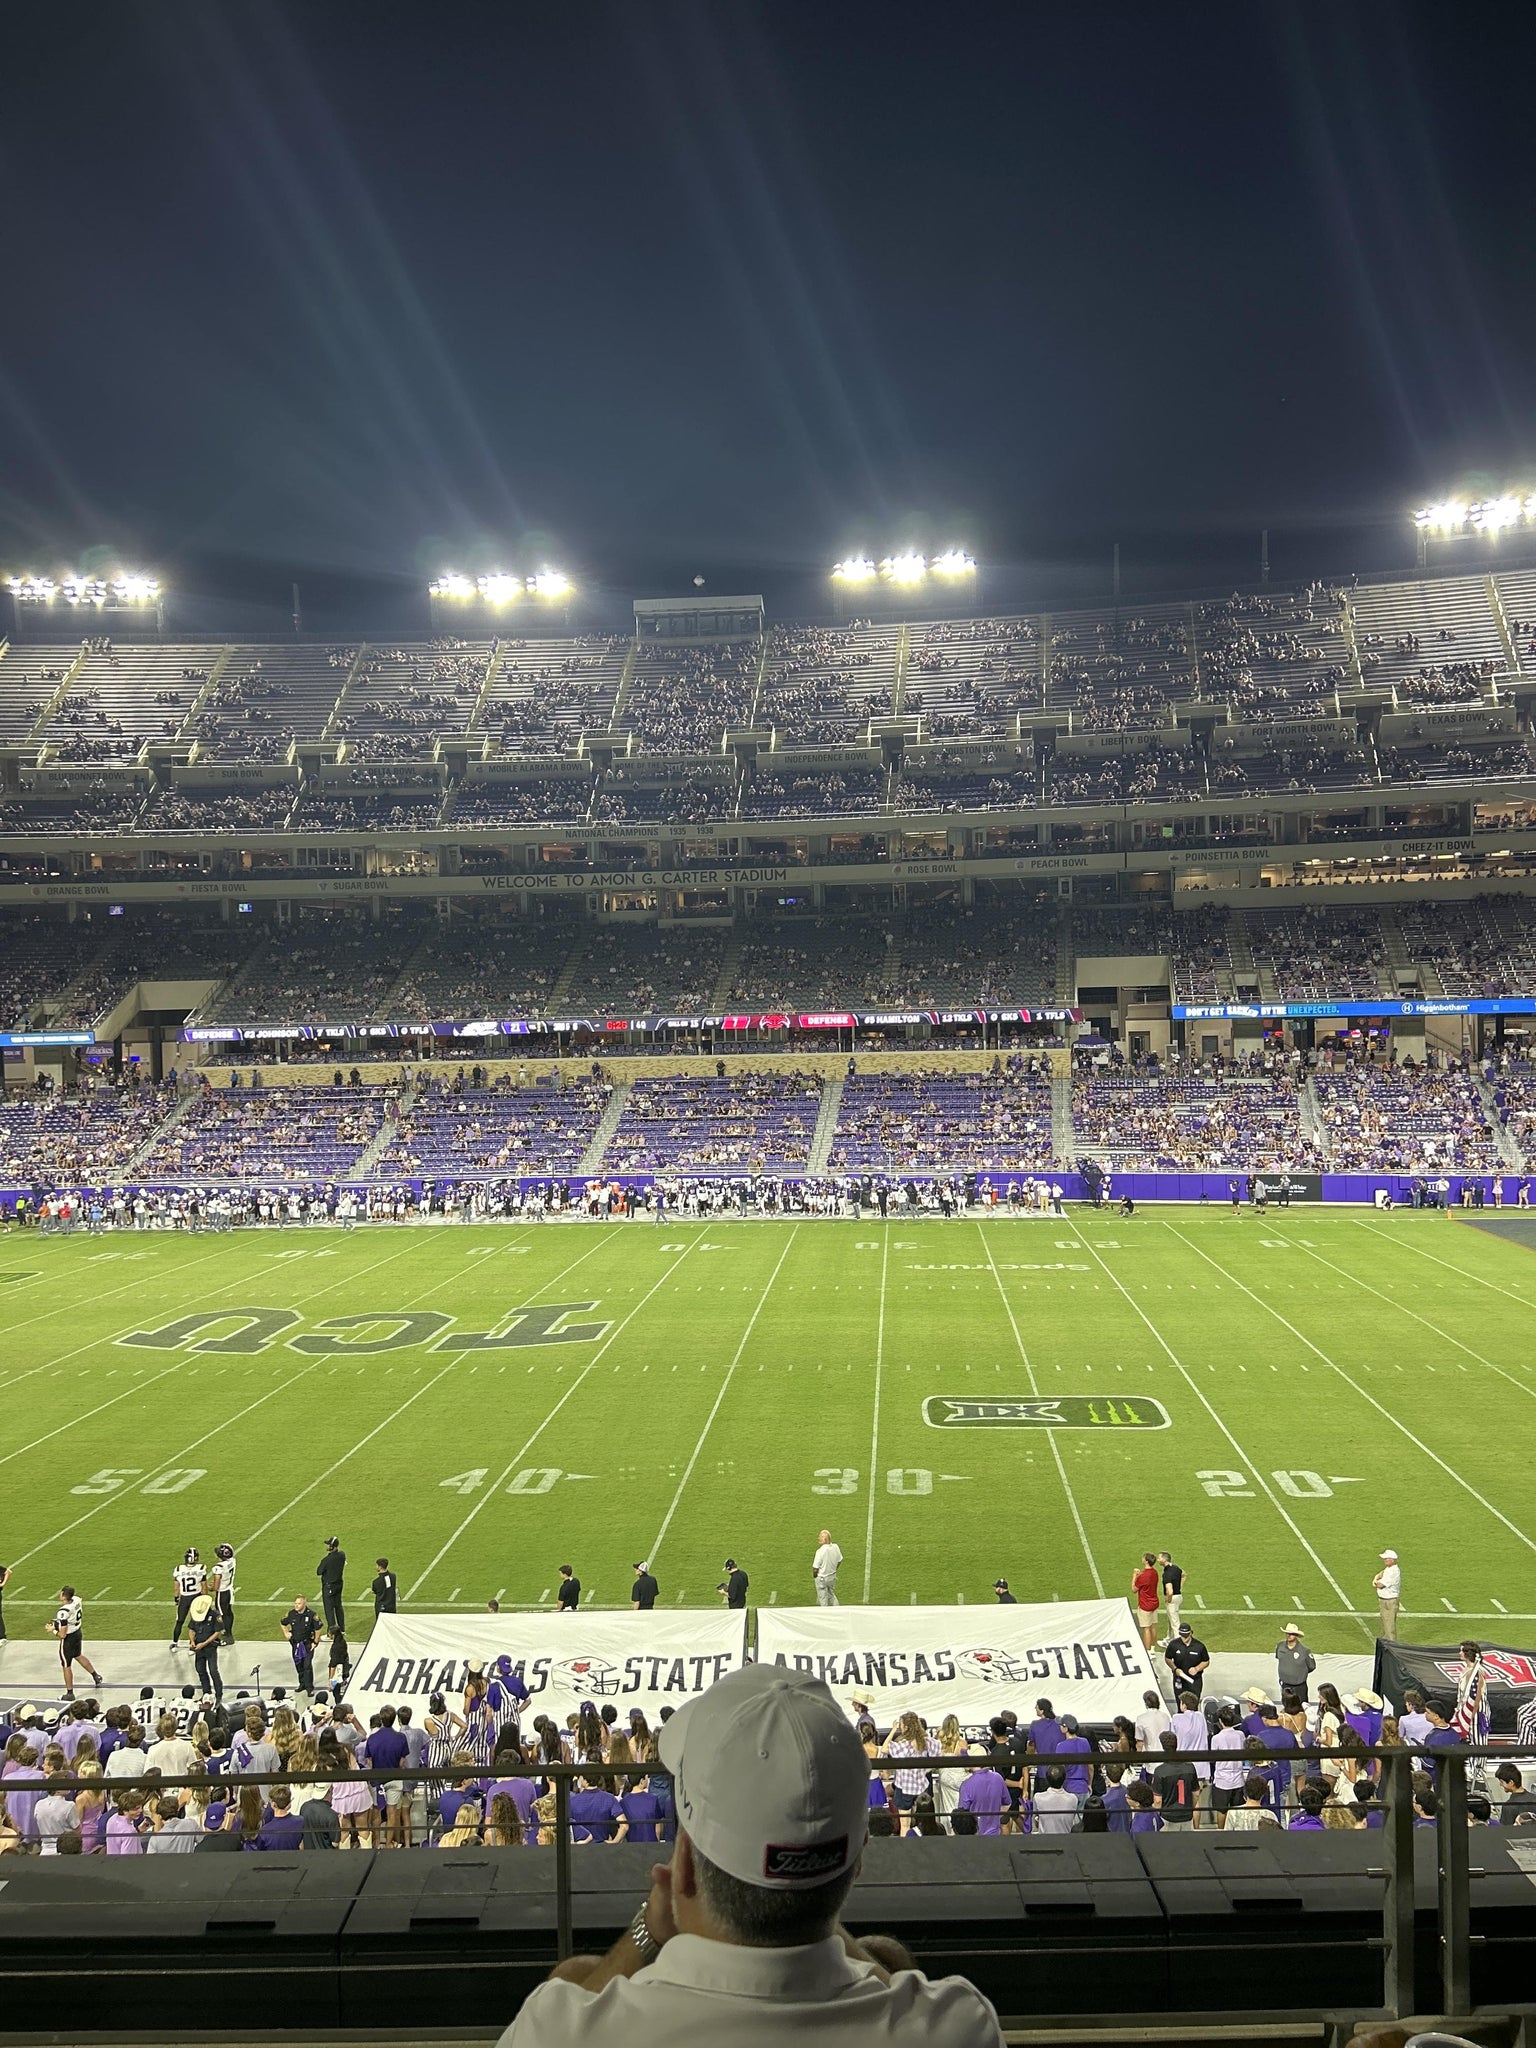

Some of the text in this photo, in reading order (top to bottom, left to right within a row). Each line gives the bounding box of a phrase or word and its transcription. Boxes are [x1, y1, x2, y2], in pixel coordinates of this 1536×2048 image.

[1427, 714, 1486, 725] TEXAS BOWL
[1252, 724, 1336, 736] FORT WORTH BOWL
[1101, 734, 1162, 746] LIBERTY BOWL
[983, 744, 1006, 753] BOWL
[784, 752, 868, 763] INDEPENDENCE BOWL
[393, 767, 416, 775] BOWL
[488, 763, 583, 773] MOBILE ALABAMA BOWL
[102, 772, 126, 780] BOWL
[222, 770, 238, 778] SUN
[565, 826, 714, 838] NATIONAL CHAMPIONS 1935 1938
[1402, 840, 1476, 852] CHEEZ-IT BOWL
[1185, 850, 1270, 862] POINSETTIA BOWL
[907, 864, 957, 874] ROSE BOWL
[1031, 858, 1088, 869] PEACH BOWL
[481, 869, 786, 888] WELCOME TO AMON G. CARTER STADIUM
[47, 886, 110, 895] ORANGE BOWL
[191, 883, 248, 892] FIESTA BOWL
[333, 881, 389, 890] SUGAR BOWL
[1287, 1006, 1339, 1014] UNEXPECTED.
[807, 1016, 848, 1024] DEFENSE
[876, 1015, 920, 1023] HAMILTON
[191, 1030, 233, 1039] DEFENSE
[914, 1263, 1091, 1271] Spectrum
[112, 1300, 615, 1356] TCU
[69, 1468, 208, 1495] 50
[438, 1468, 563, 1495] 40
[811, 1468, 933, 1496] 30
[1195, 1469, 1334, 1498] 20
[181, 1577, 196, 1593] 12
[1026, 1640, 1142, 1680] STATE
[134, 1705, 152, 1724] 31
[1177, 1779, 1186, 1805] 1
[1268, 1779, 1276, 1805] 1
